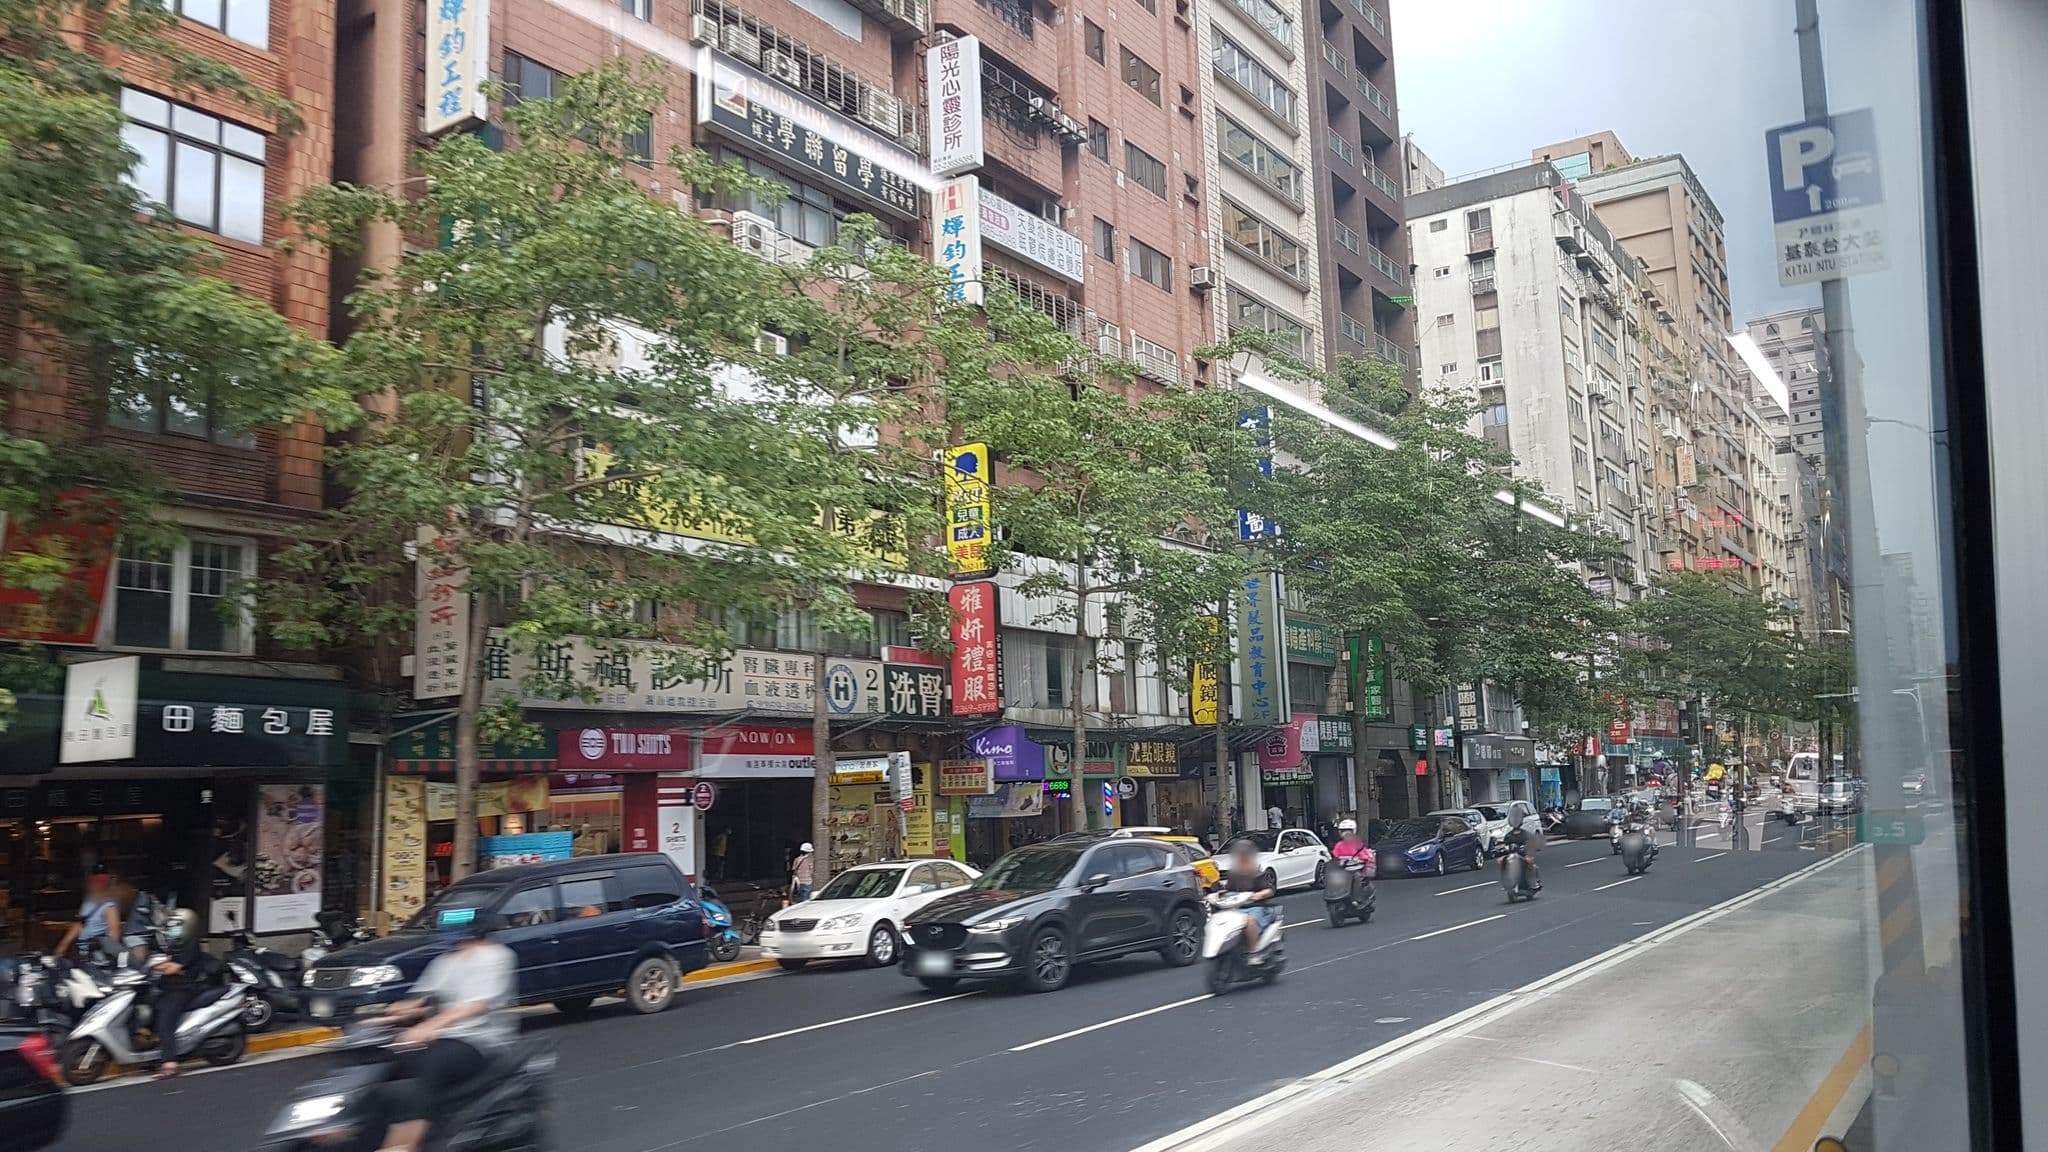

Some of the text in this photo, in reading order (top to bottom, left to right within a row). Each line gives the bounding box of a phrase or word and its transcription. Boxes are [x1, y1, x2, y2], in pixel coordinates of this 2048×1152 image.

[940, 42, 962, 152] 陽光心靈診所
[776, 116, 874, 190] 學聯留學
[1779, 127, 1835, 191] P
[1784, 263, 1813, 278] KITAI
[1816, 260, 1836, 271] NTU
[960, 586, 986, 702] 雅妍禮服
[865, 668, 878, 691] 2
[891, 670, 943, 716] 洗腎
[788, 758, 816, 770] outle
